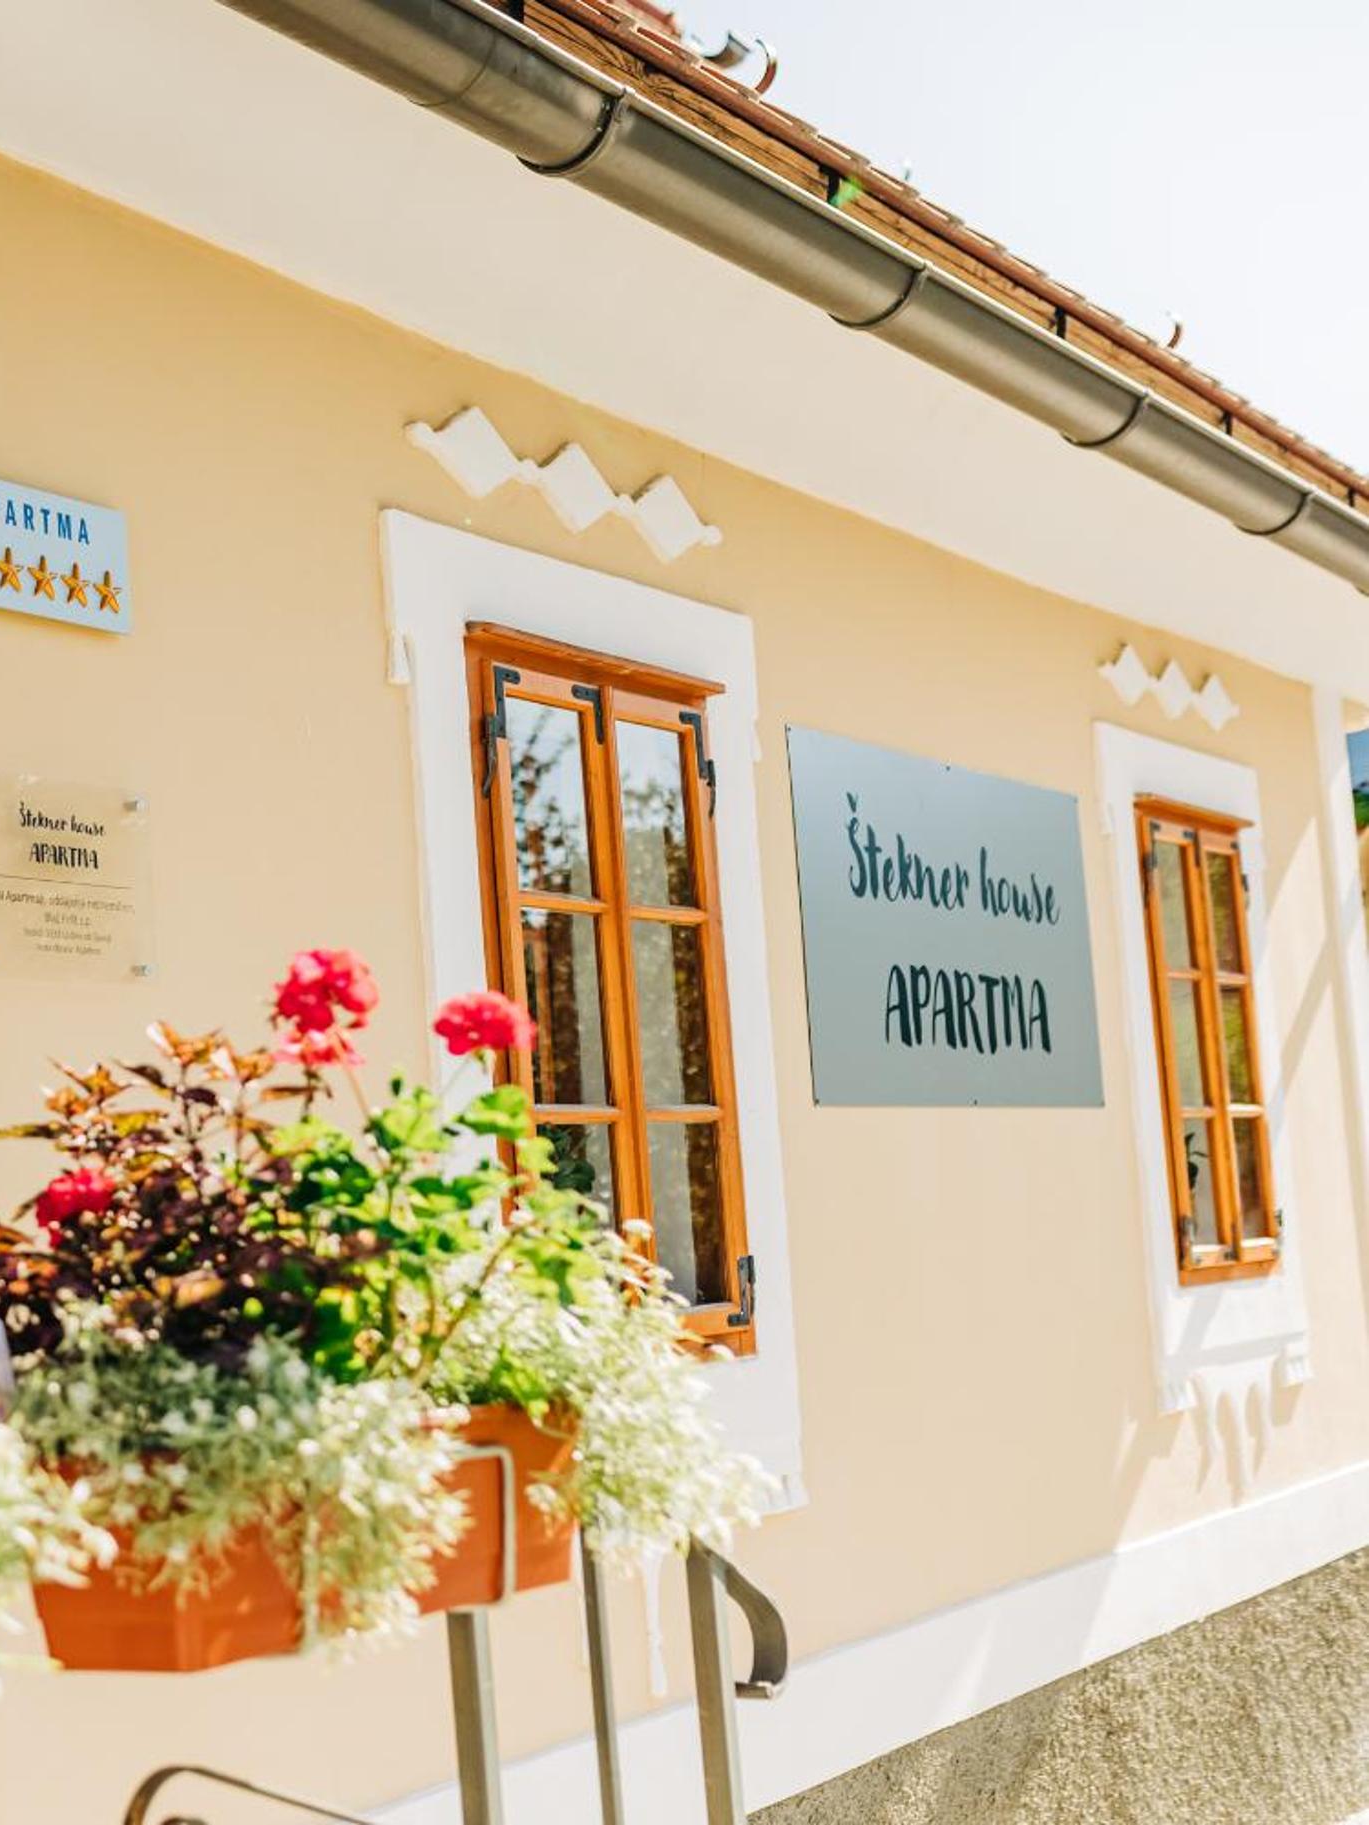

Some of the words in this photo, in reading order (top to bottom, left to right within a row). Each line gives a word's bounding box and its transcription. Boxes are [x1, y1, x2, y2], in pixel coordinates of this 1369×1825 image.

[19, 801, 67, 831] Štekner
[71, 814, 105, 836] house
[29, 842, 98, 869] APARTMA
[846, 792, 969, 910] Štekner
[980, 846, 1060, 926] house
[885, 964, 1052, 1055] APARTMA
